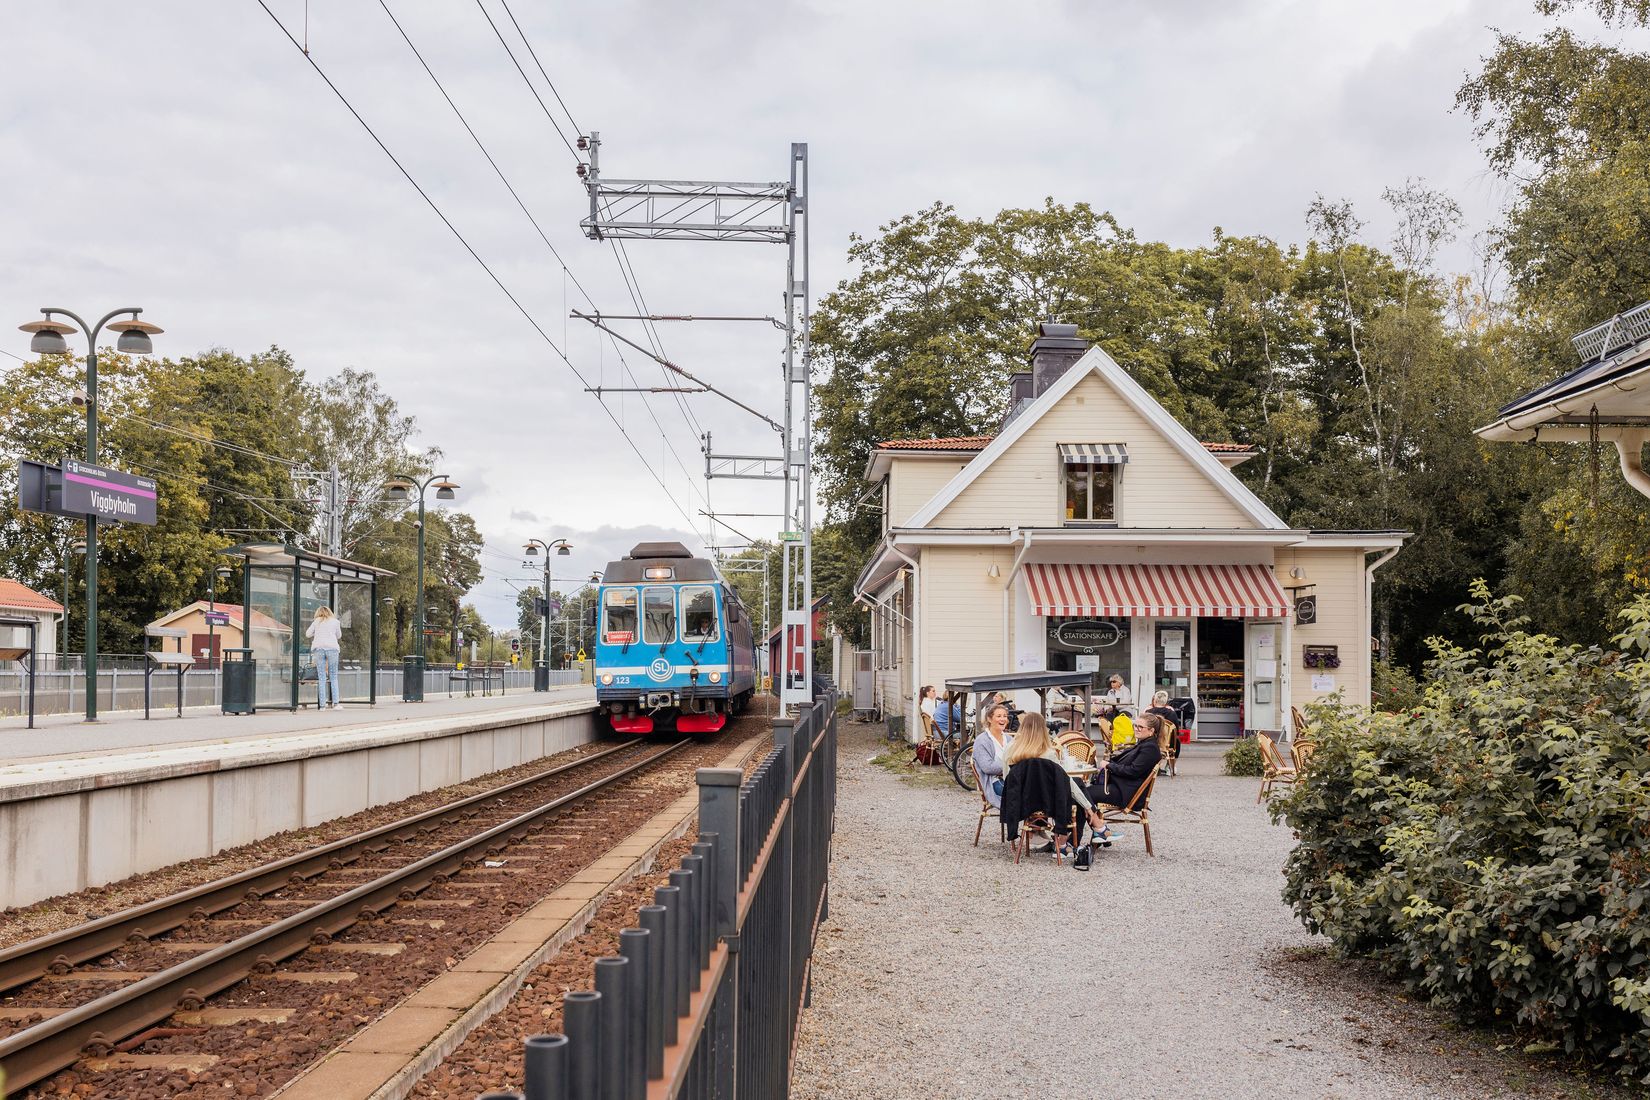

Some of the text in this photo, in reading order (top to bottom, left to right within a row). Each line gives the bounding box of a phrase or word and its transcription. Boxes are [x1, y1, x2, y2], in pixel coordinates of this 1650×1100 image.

[90, 490, 136, 515] Viggbyholm
[654, 662, 667, 672] SL
[616, 676, 630, 684] 123
[764, 680, 770, 688] 3
